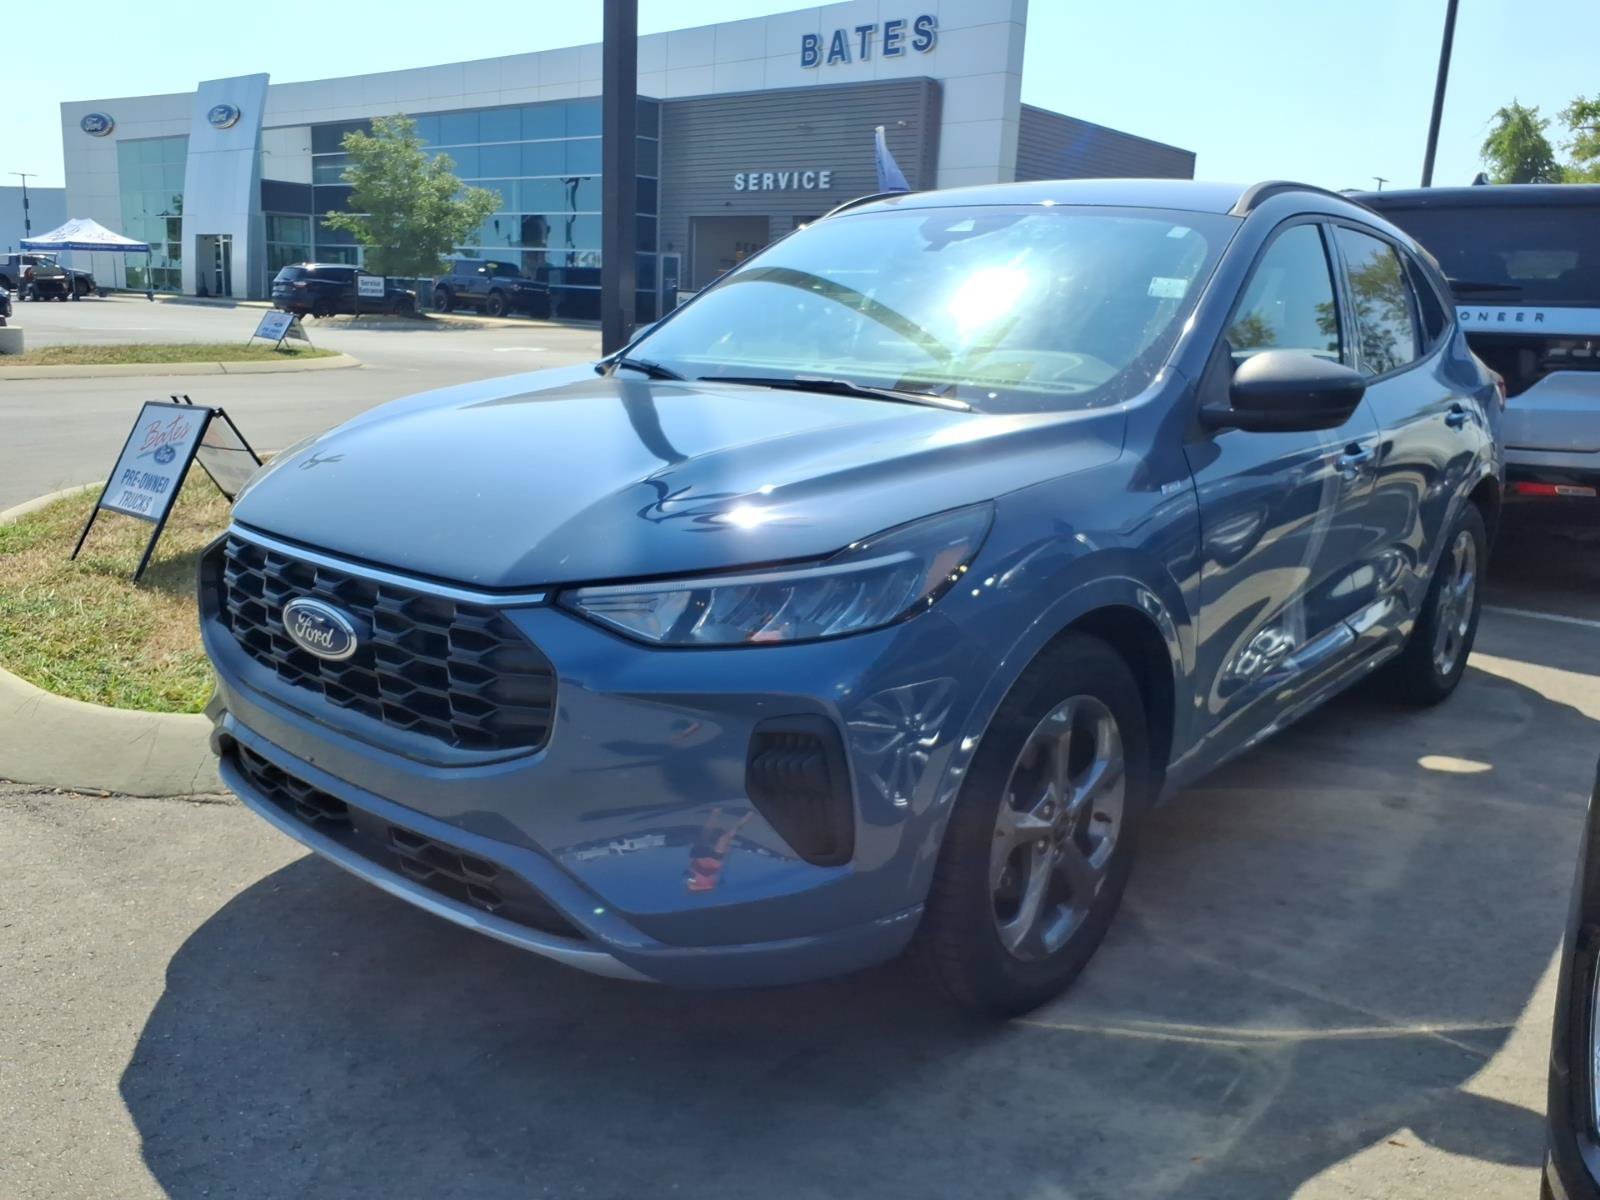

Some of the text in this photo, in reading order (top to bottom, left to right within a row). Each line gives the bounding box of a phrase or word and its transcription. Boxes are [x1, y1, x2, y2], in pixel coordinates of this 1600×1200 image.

[801, 15, 937, 68] BATES
[734, 171, 831, 191] SERVICE
[140, 415, 191, 451] Bates
[121, 469, 170, 494] PRE-OWNED
[119, 490, 153, 513] TRUCKS
[295, 610, 335, 648] Ford
